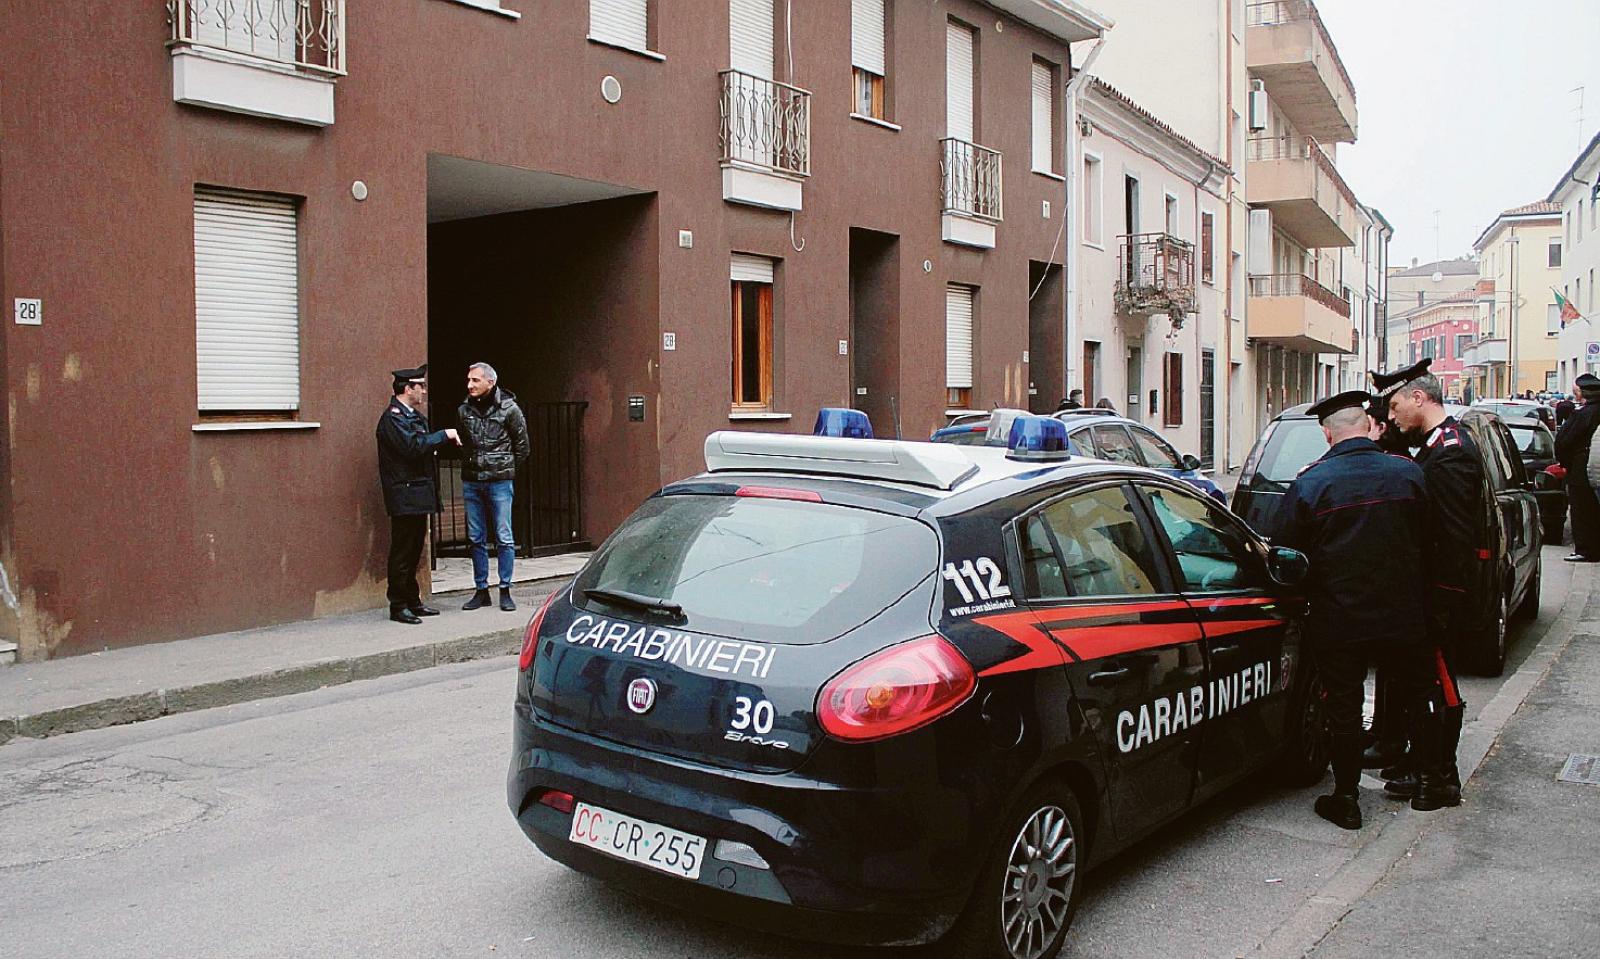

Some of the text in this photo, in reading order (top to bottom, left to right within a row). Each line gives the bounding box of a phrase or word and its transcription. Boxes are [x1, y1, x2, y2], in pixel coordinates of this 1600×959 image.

[942, 557, 1011, 603] 112
[566, 615, 776, 679] CARABINIERI
[632, 687, 649, 705] FIAT
[731, 696, 774, 734] 30
[1116, 660, 1271, 753] CARABINIERI
[724, 730, 789, 749] Bravo
[575, 808, 700, 872] CC CR 255
